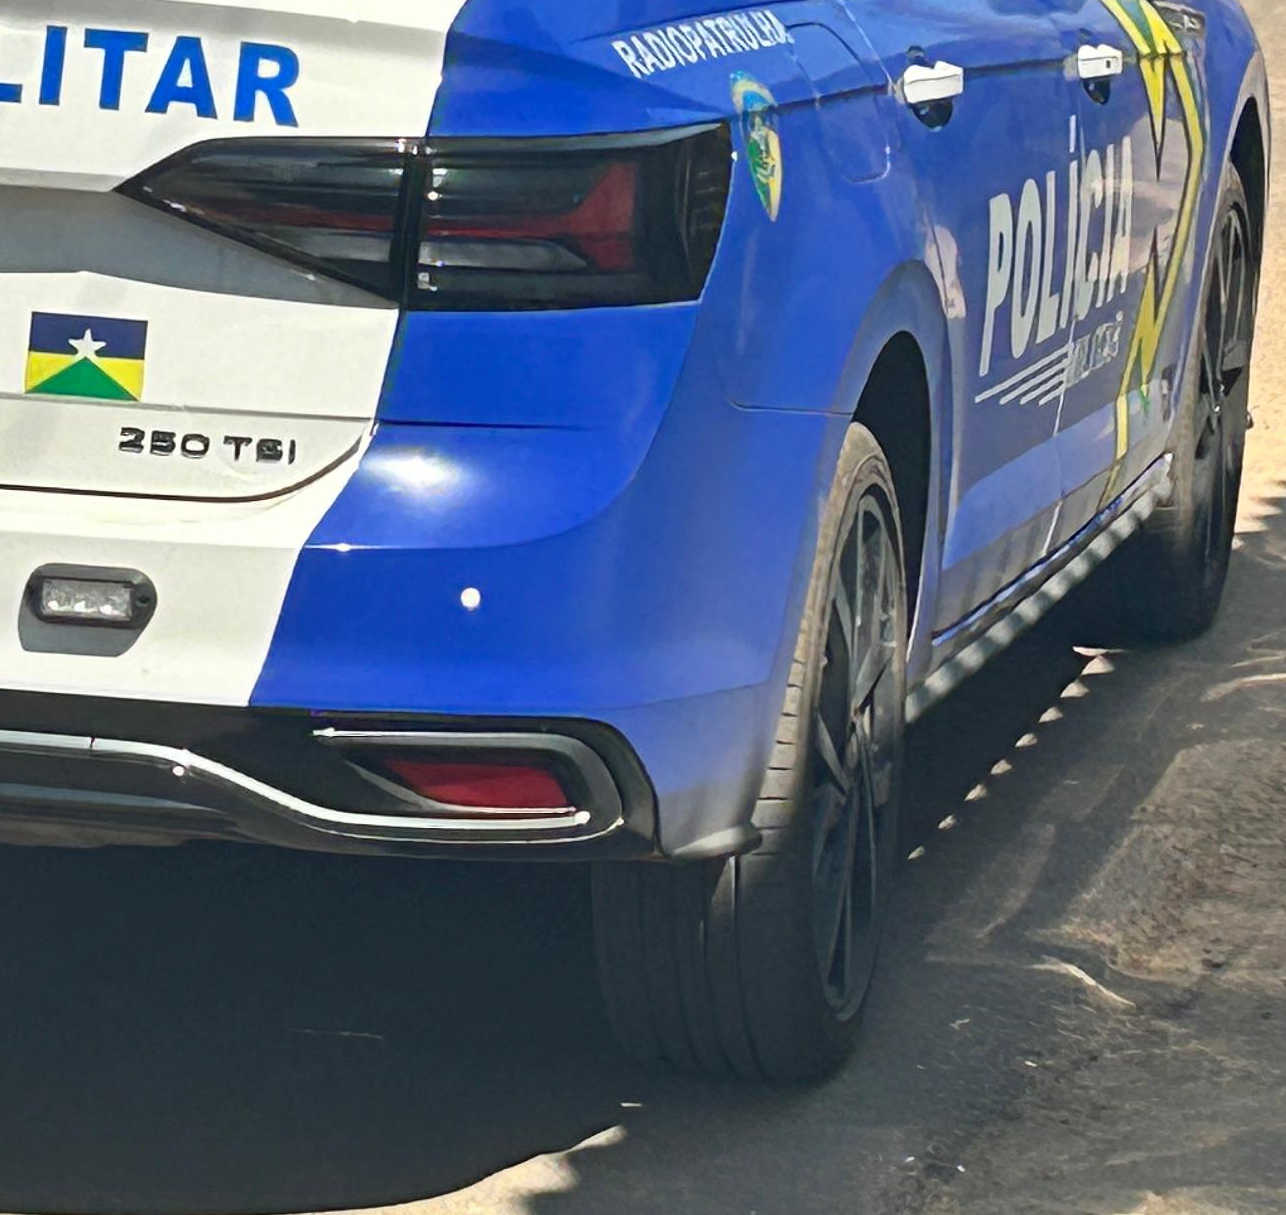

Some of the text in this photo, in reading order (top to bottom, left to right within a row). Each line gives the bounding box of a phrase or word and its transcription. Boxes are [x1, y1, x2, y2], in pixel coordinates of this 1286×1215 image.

[978, 114, 1133, 378] POLÍCIA
[118, 426, 298, 466] 250 TSI
